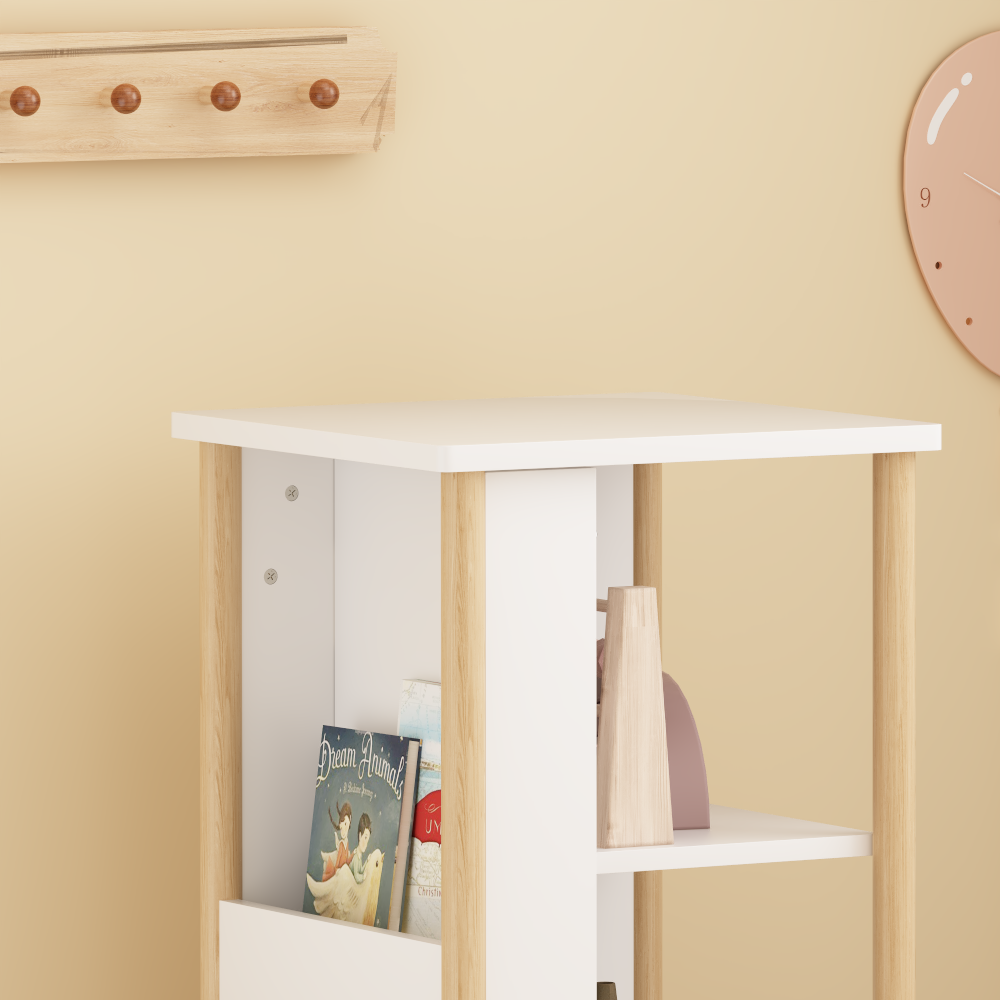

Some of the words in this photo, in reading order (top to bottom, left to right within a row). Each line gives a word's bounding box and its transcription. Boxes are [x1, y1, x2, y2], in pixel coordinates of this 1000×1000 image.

[919, 187, 931, 208] 9
[315, 733, 357, 789] Dream
[358, 731, 405, 800] Animals
